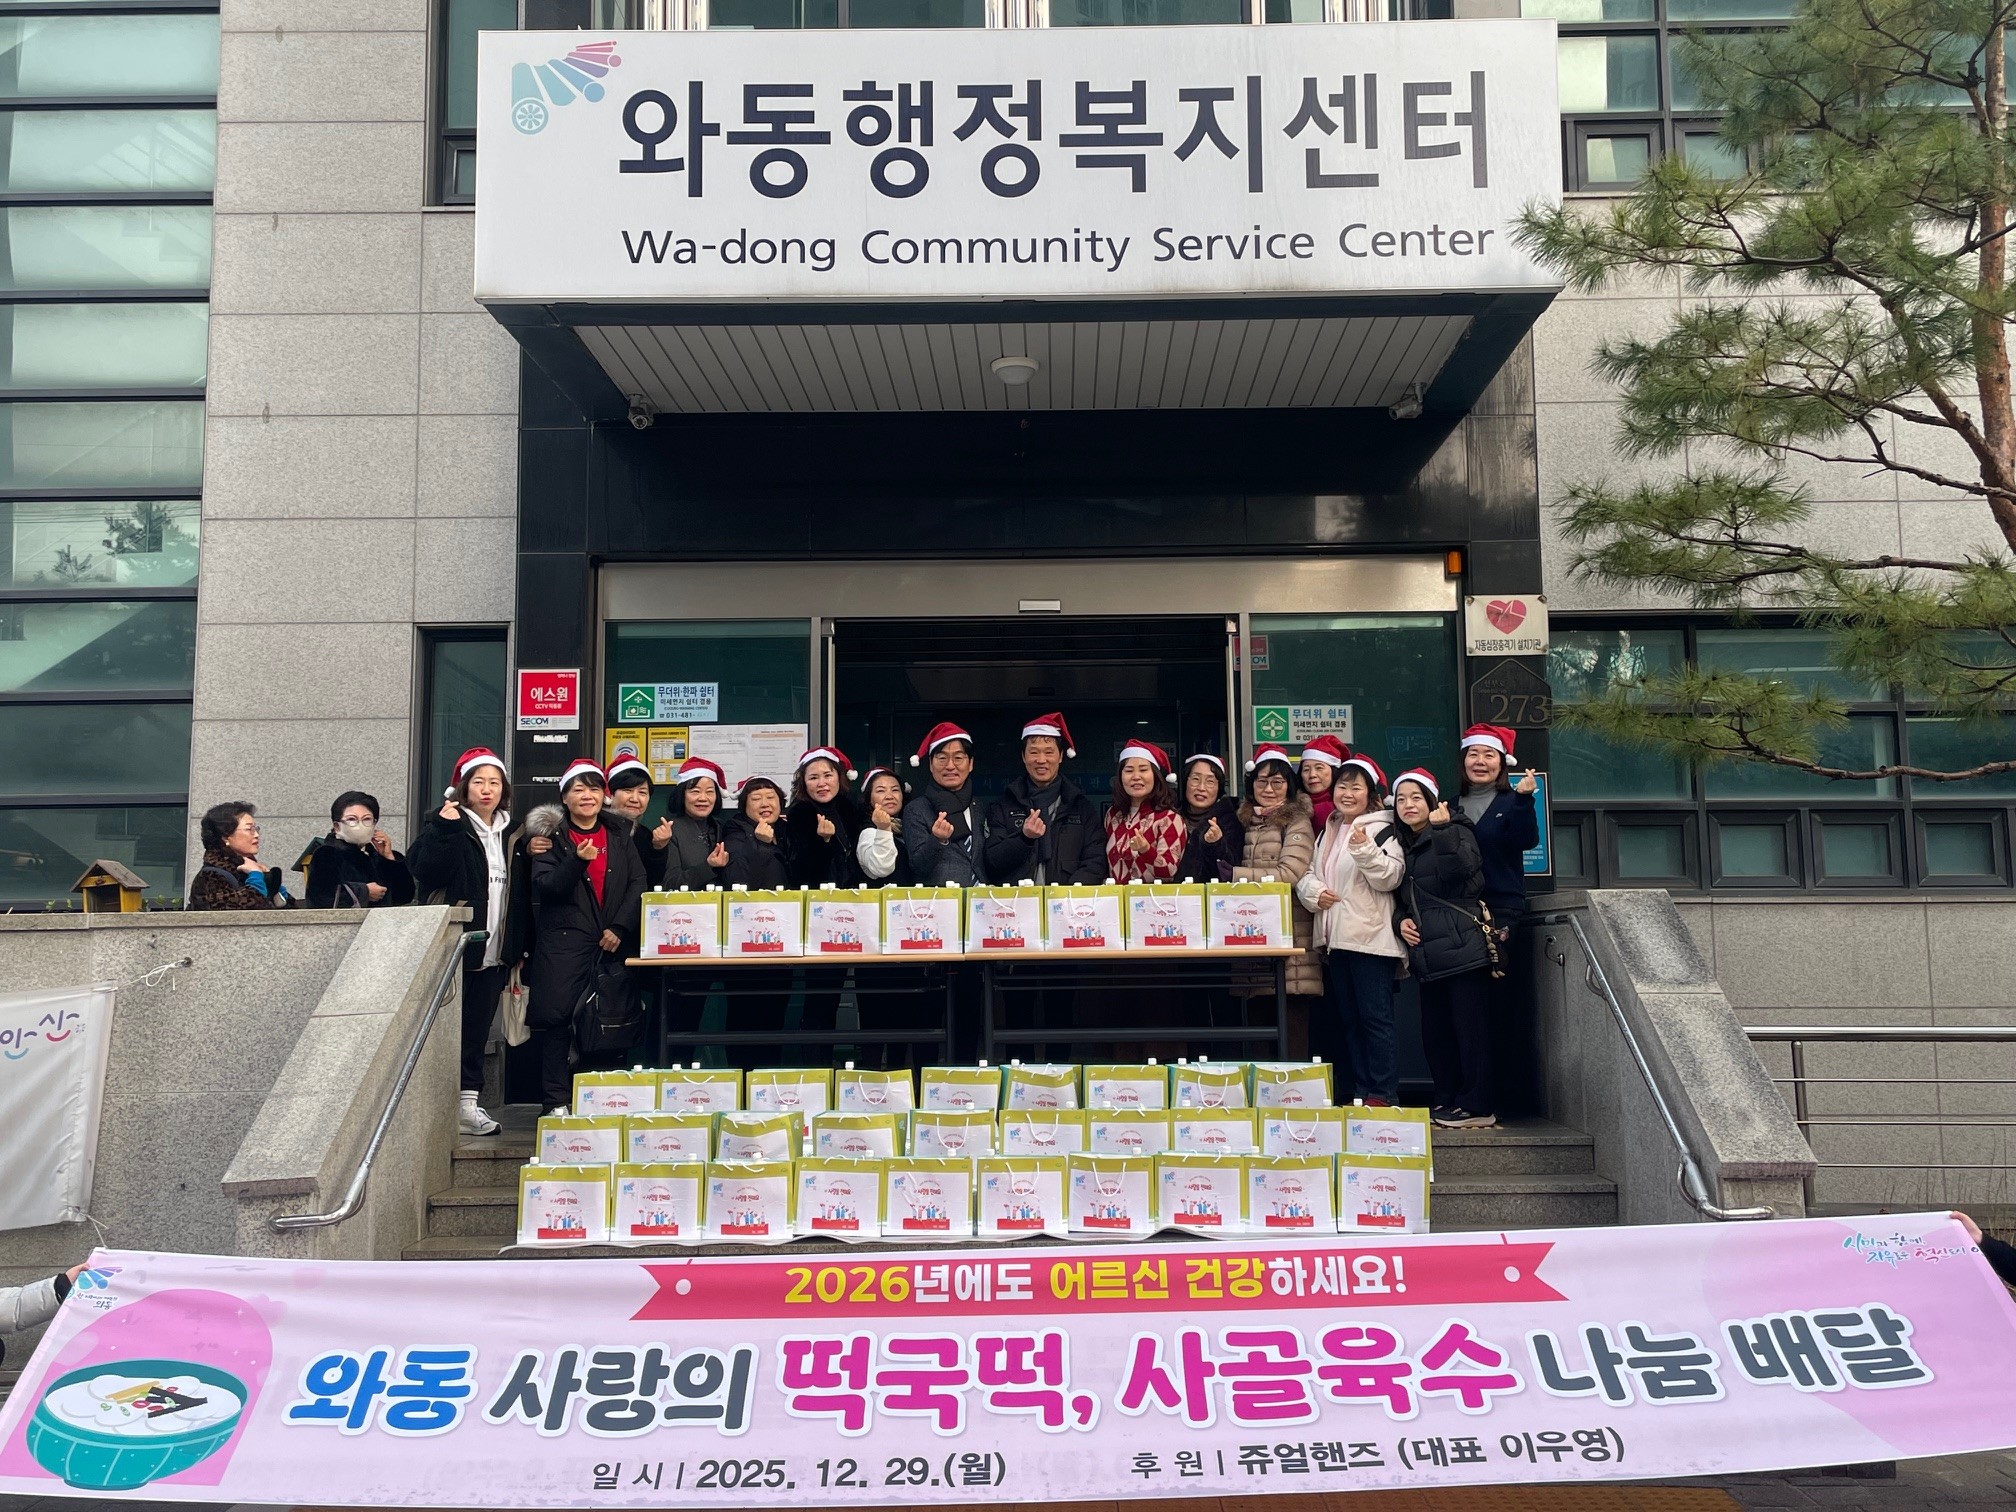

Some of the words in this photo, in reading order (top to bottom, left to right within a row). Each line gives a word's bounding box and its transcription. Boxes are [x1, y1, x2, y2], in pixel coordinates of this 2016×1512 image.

[619, 71, 1488, 198] 와동행정복지센터
[622, 228, 836, 271] Wa-dong
[862, 227, 1130, 272] Community
[1153, 225, 1314, 262] Service
[1339, 223, 1494, 258] Center
[1475, 639, 1516, 652] 자동심장충격기
[1517, 638, 1541, 651] 설치기관
[530, 687, 568, 702] 에스원
[699, 686, 715, 698] 쉼터
[1490, 694, 1548, 723] 273
[1292, 708, 1322, 719] 무더위
[1328, 708, 1347, 719] 쉼터
[784, 1263, 1034, 1304] 2026년에도
[1050, 1259, 1170, 1301] 어르신
[1185, 1255, 1407, 1299] 건강하세요!
[289, 1348, 472, 1431] 와동
[487, 1347, 753, 1432] 사랑의
[782, 1332, 1094, 1430] 떡국떡,
[1122, 1323, 1518, 1423] 사골육수
[1534, 1325, 1712, 1400] 나눔
[1728, 1308, 1926, 1387] 배달
[1237, 1441, 1385, 1475] 쥬얼핸즈
[1398, 1436, 1488, 1470] (대표
[1500, 1426, 1625, 1463] 이우영)
[695, 1459, 796, 1489] 2025.
[816, 1458, 868, 1488] 12.
[884, 1452, 1006, 1488] 29.(월)
